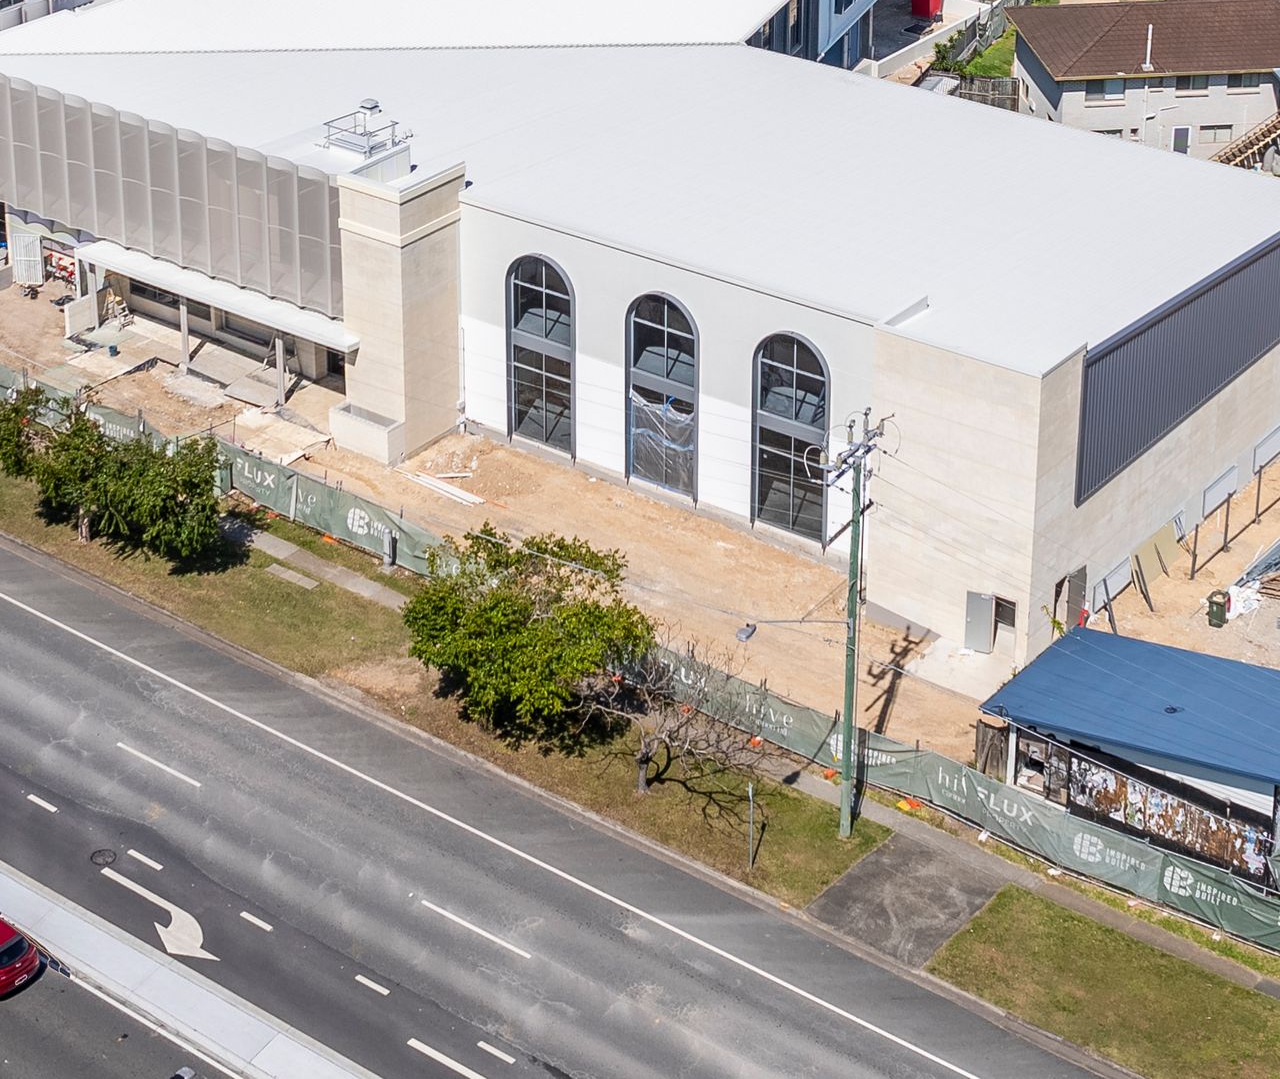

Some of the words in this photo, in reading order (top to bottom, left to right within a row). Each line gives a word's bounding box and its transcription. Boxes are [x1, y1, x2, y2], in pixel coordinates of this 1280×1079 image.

[746, 695, 793, 728] hive
[976, 786, 1034, 827] FLUX
[1105, 855, 1130, 871] BUILT
[1106, 848, 1146, 870] INSPIRED
[1194, 889, 1222, 907] BUILT
[1196, 881, 1239, 906] INSPIRED
